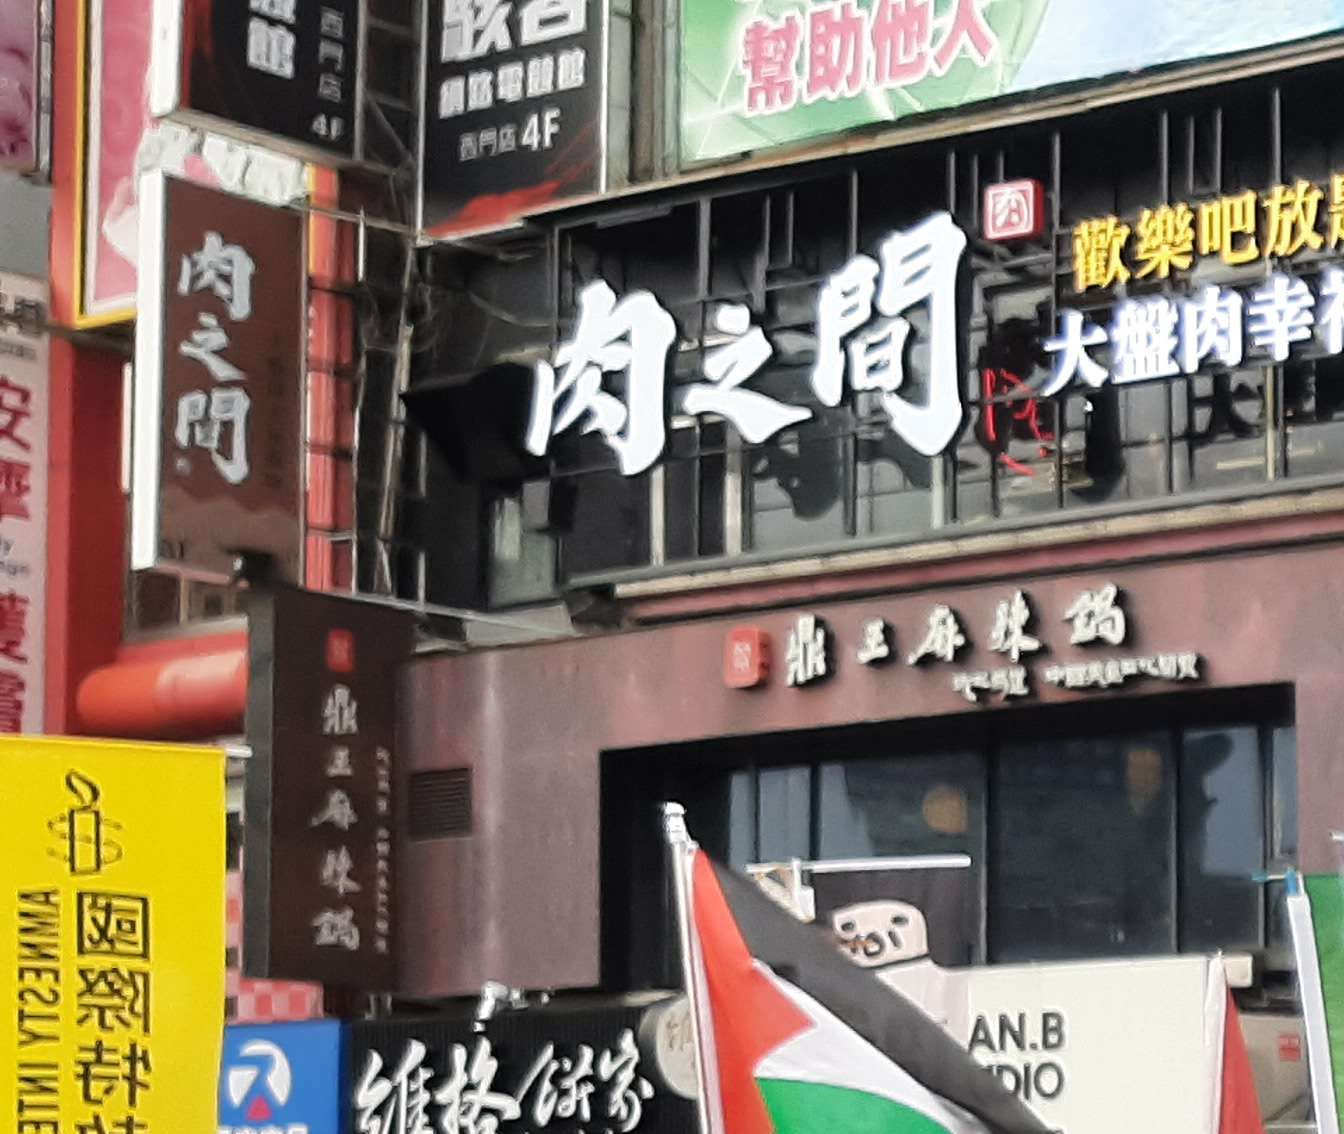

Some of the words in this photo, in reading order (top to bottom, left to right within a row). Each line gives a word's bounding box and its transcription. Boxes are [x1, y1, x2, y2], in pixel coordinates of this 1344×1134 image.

[743, 0, 994, 113] 幫助他人
[521, 107, 561, 153] 4F
[177, 231, 256, 485] 肉之間
[525, 210, 970, 476] 肉之間
[968, 1012, 1065, 1054] AN.B
